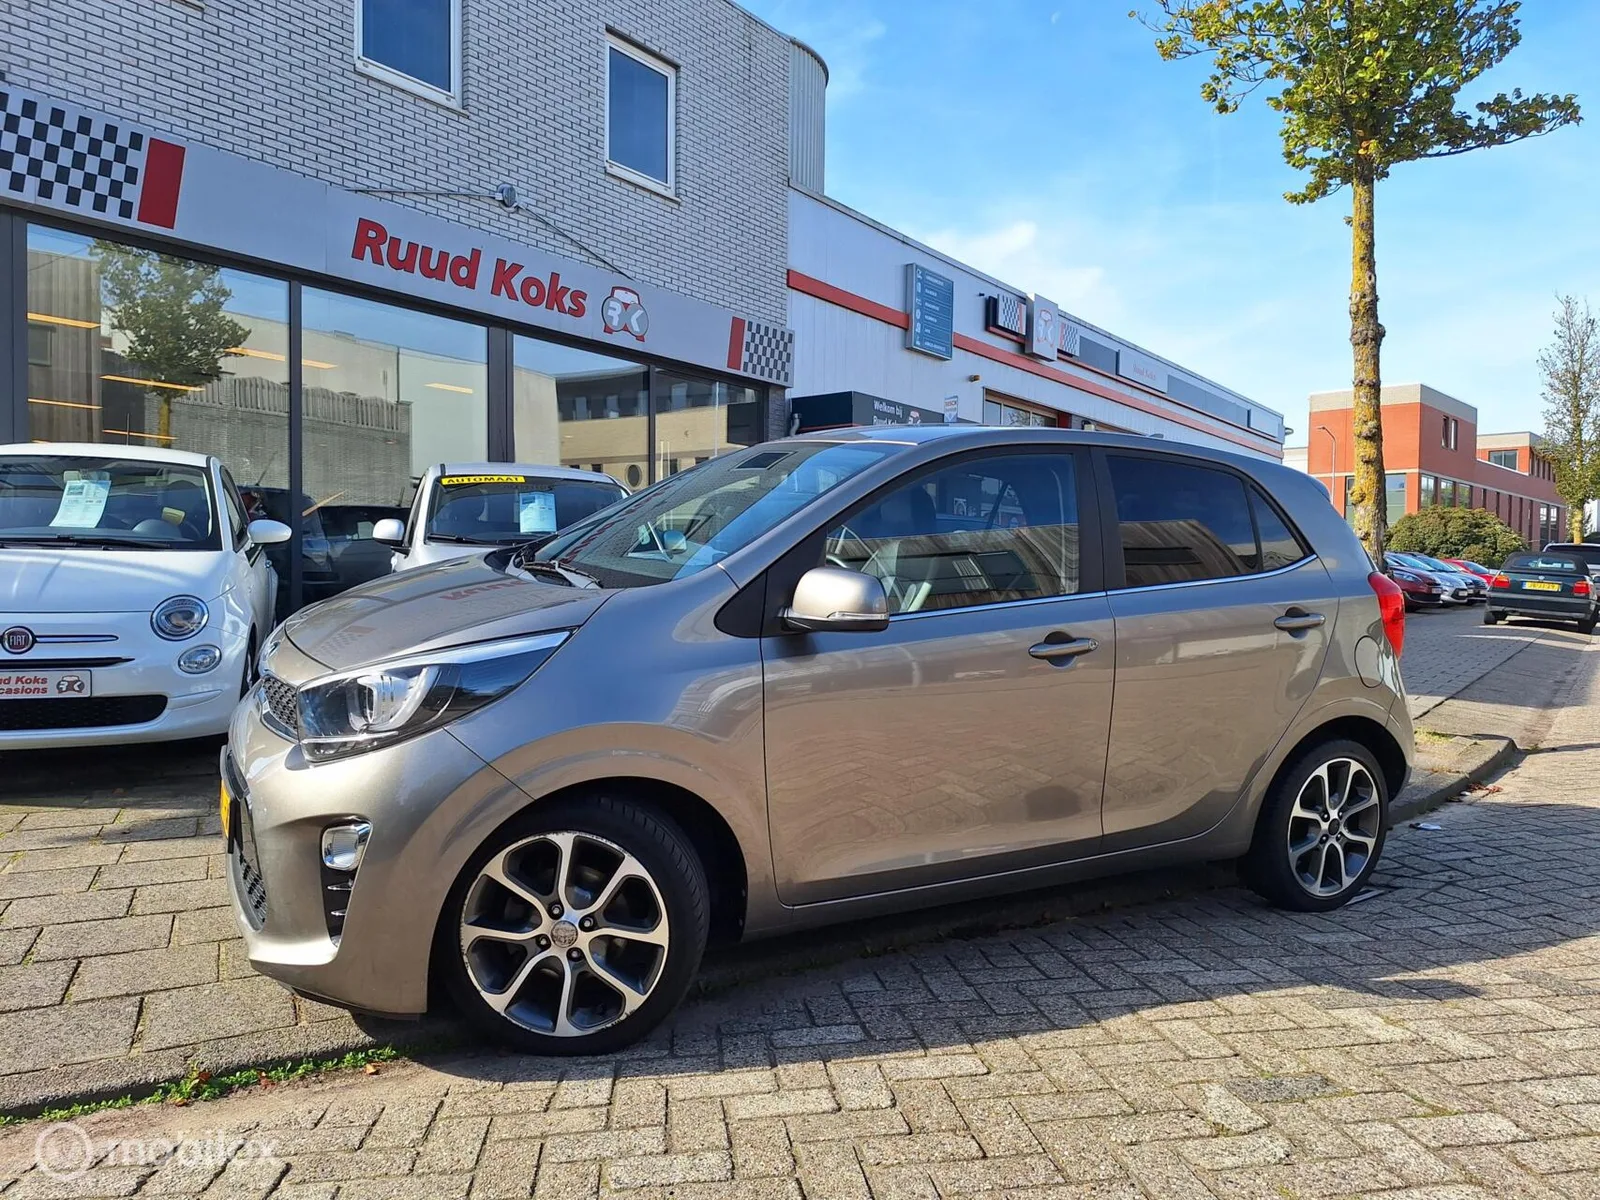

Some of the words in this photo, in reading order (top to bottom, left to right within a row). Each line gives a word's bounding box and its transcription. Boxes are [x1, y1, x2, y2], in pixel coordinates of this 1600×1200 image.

[351, 217, 482, 290] Ruud
[490, 258, 588, 318] Koks
[873, 400, 896, 415] Welkom
[9, 635, 26, 646] FIAT
[15, 675, 48, 685] Koks
